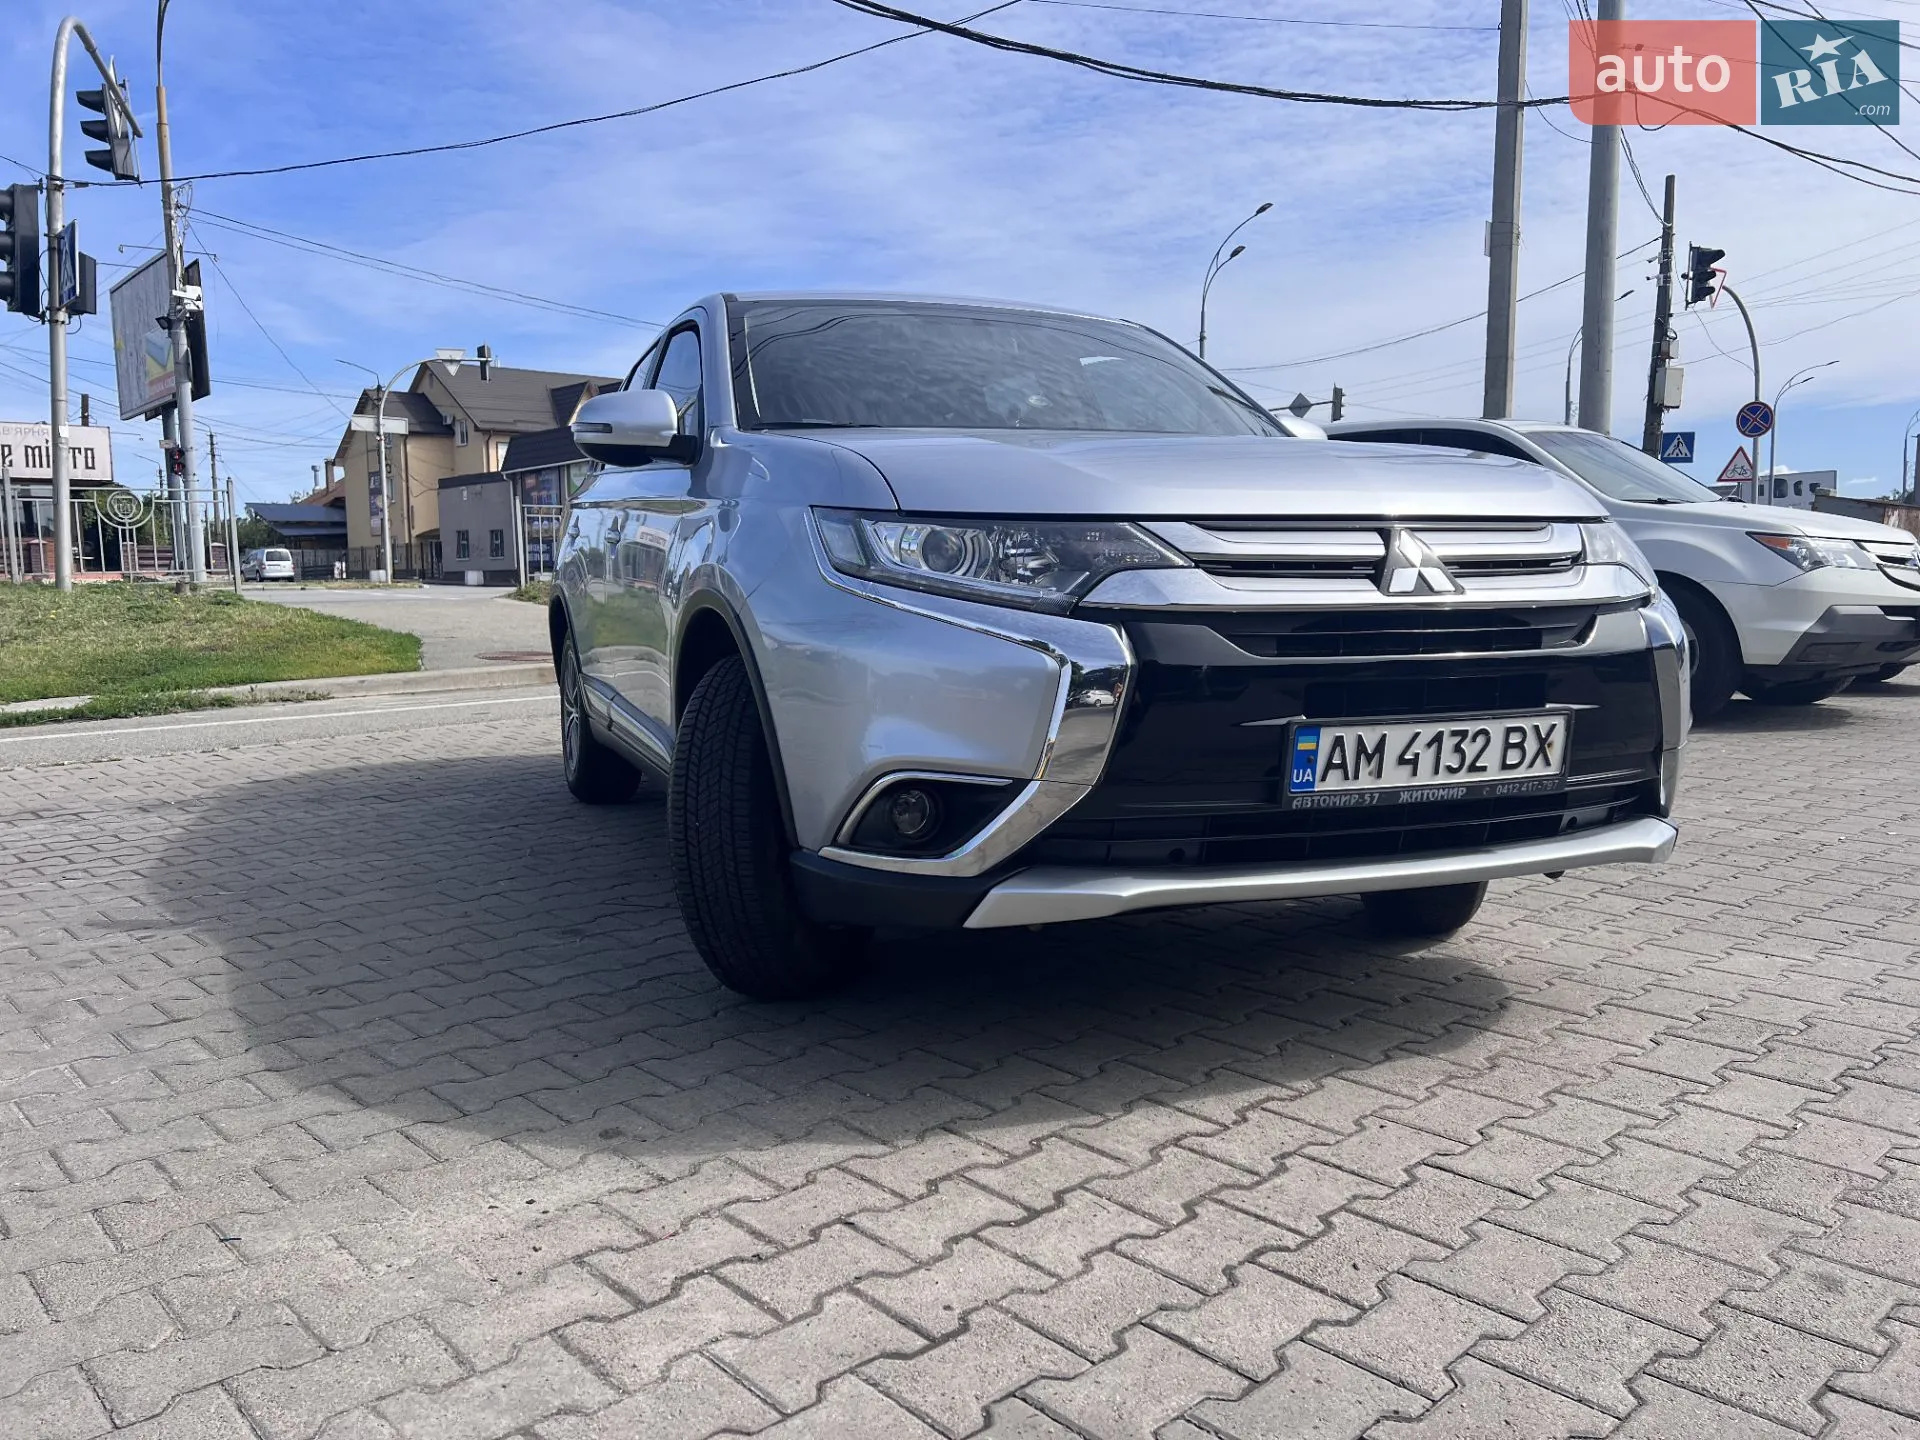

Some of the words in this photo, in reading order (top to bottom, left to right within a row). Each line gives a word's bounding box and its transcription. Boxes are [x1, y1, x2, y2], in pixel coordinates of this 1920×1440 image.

[24, 437, 96, 469] міто
[1320, 731, 1388, 782] AM
[1397, 727, 1493, 777] 4132
[1500, 722, 1558, 770] BX
[1292, 769, 1314, 783] UA
[1292, 792, 1380, 809] АВТОМИР-57
[1398, 787, 1467, 804] ЖИТОМИР
